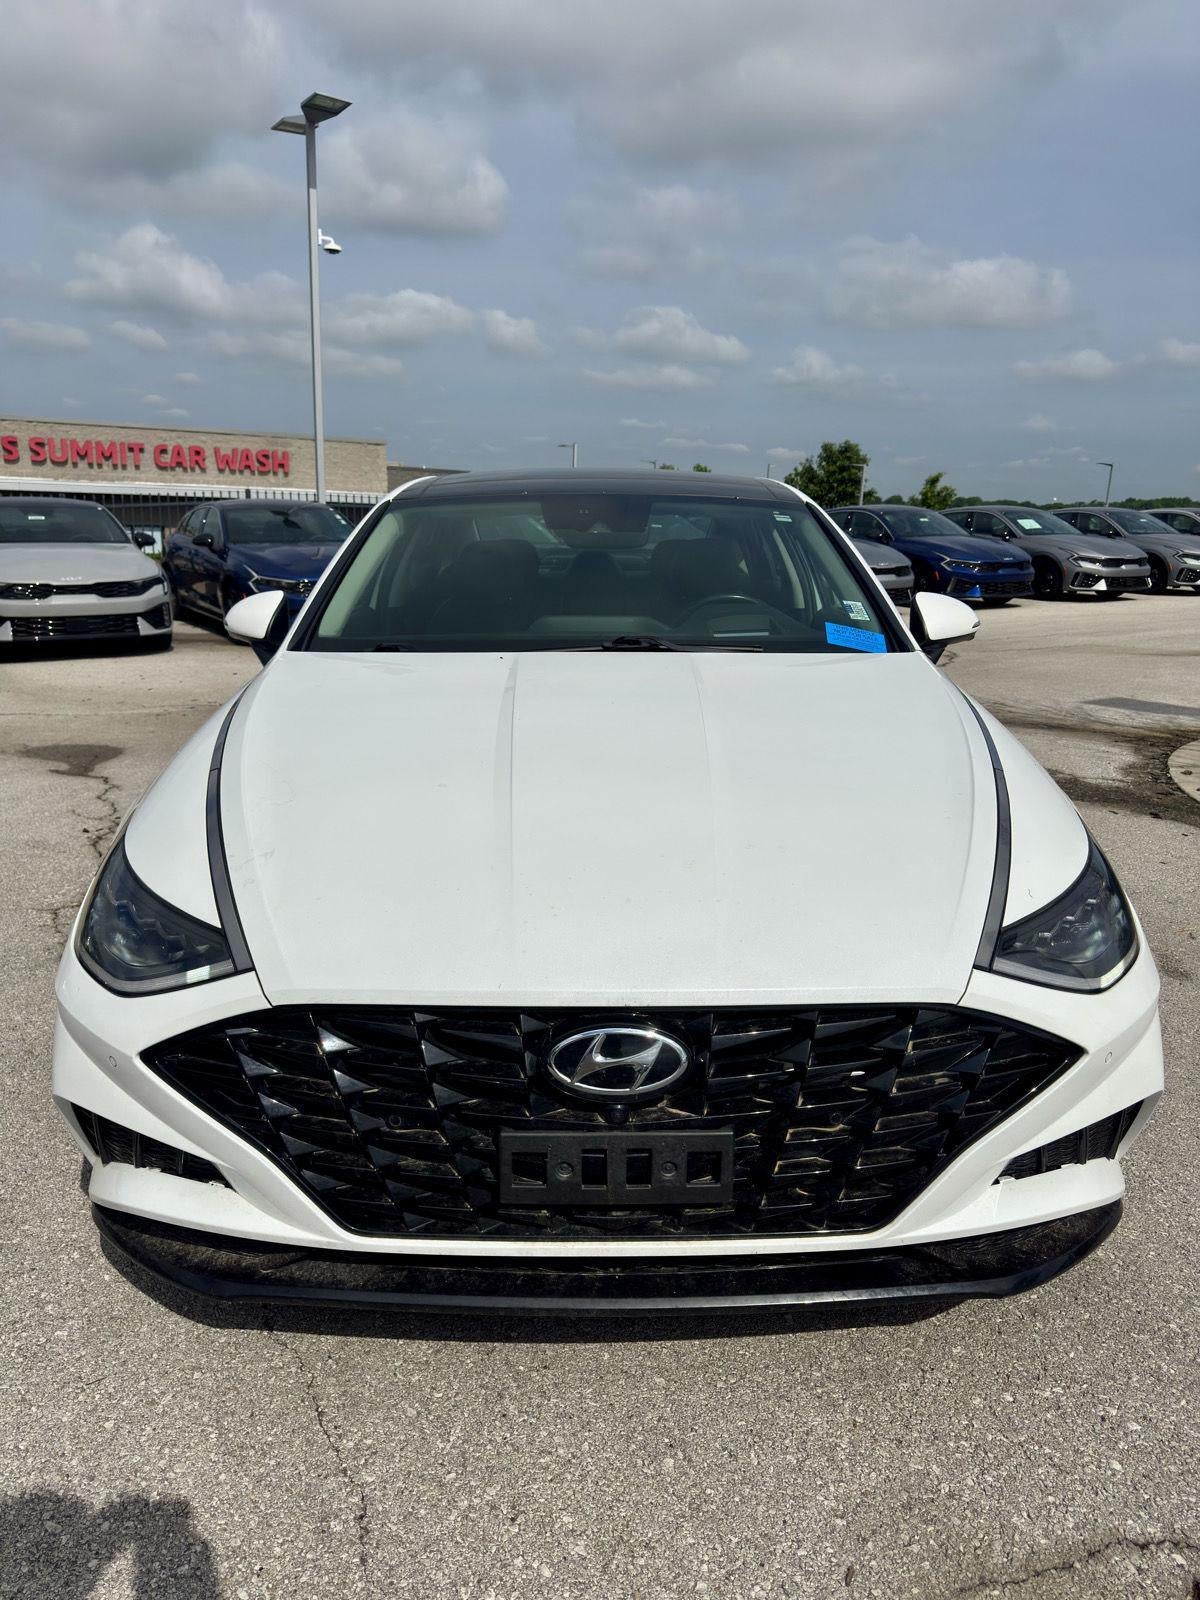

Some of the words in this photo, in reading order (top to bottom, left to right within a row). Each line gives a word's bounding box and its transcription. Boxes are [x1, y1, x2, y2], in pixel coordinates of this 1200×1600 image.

[28, 437, 145, 466] SUMMIT
[153, 444, 206, 469] CAR
[213, 446, 289, 473] WASH
